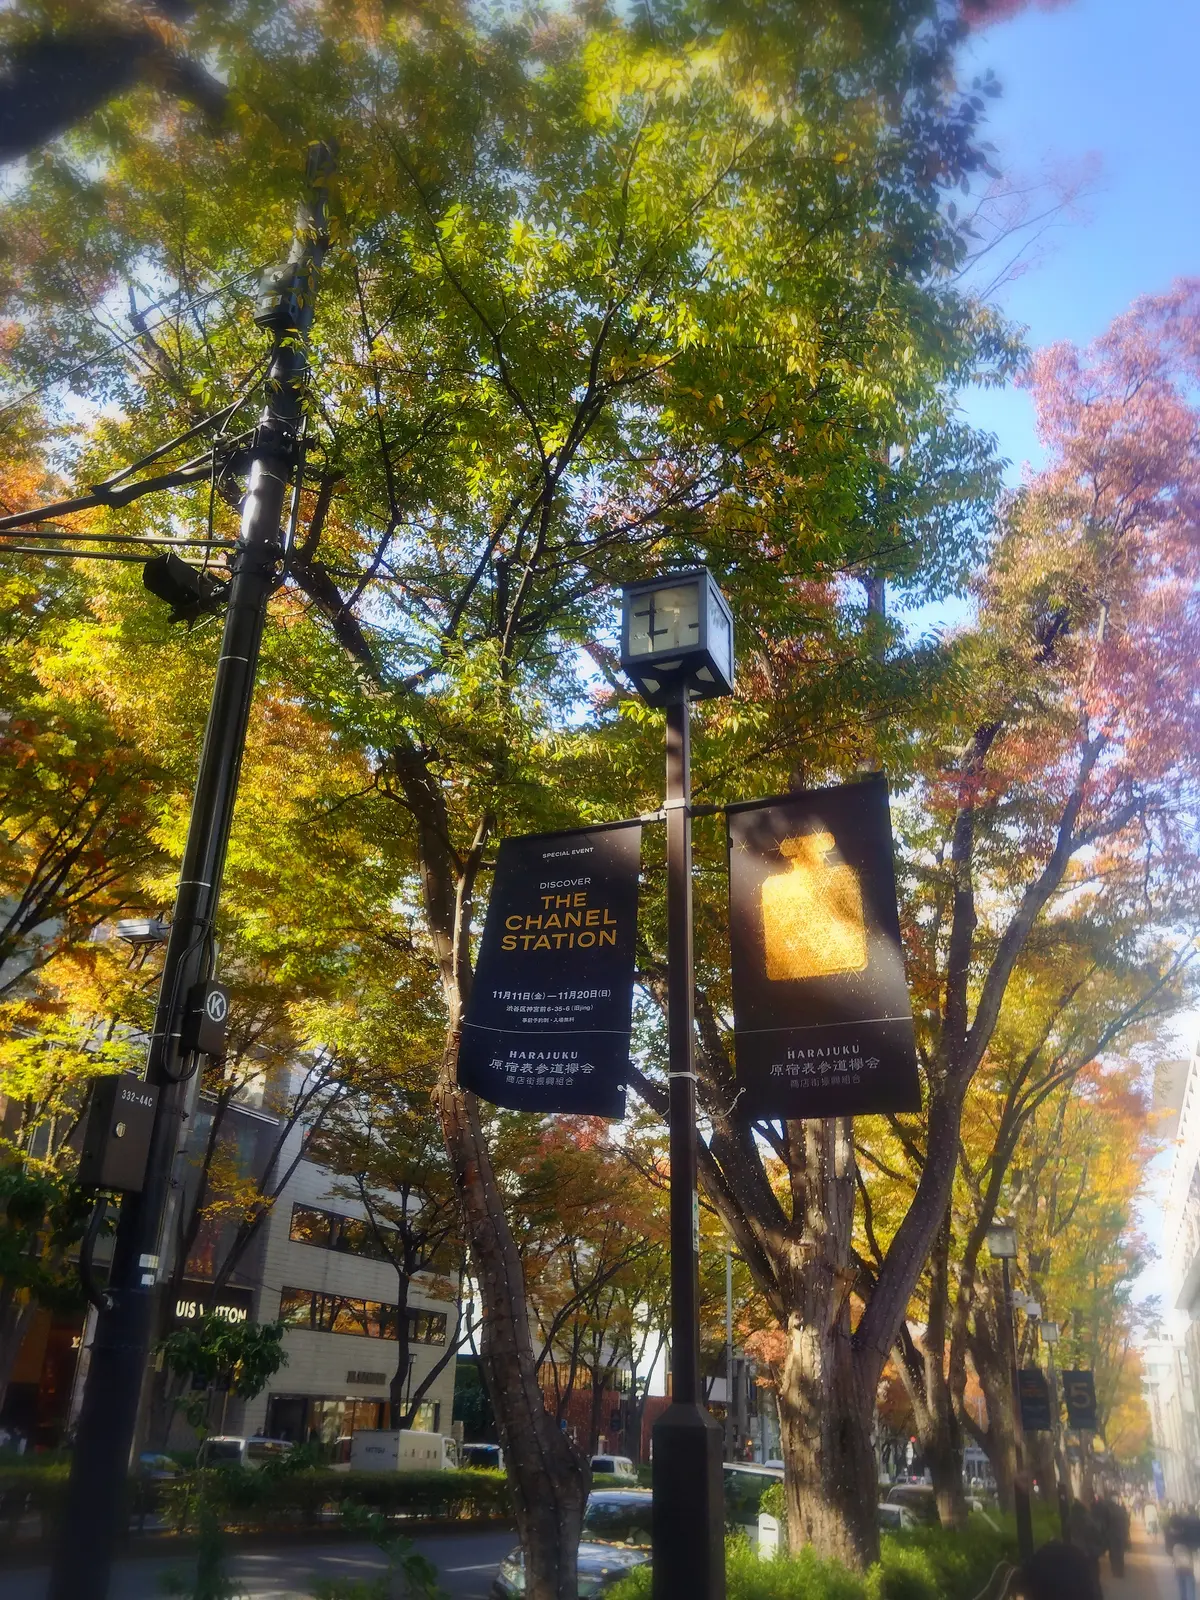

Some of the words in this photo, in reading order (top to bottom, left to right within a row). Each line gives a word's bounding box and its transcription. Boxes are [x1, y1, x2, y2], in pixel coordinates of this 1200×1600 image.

[542, 850, 570, 859] SPECIAL
[571, 847, 594, 856] EVENT
[540, 877, 591, 889] DISCOVER
[541, 892, 587, 910] THE
[505, 908, 617, 931] CHANEL
[501, 929, 617, 951] STATION
[509, 1050, 578, 1060] HARAJUKU
[787, 1045, 859, 1059] HARAJUKU
[121, 1089, 153, 1107] 332-44C
